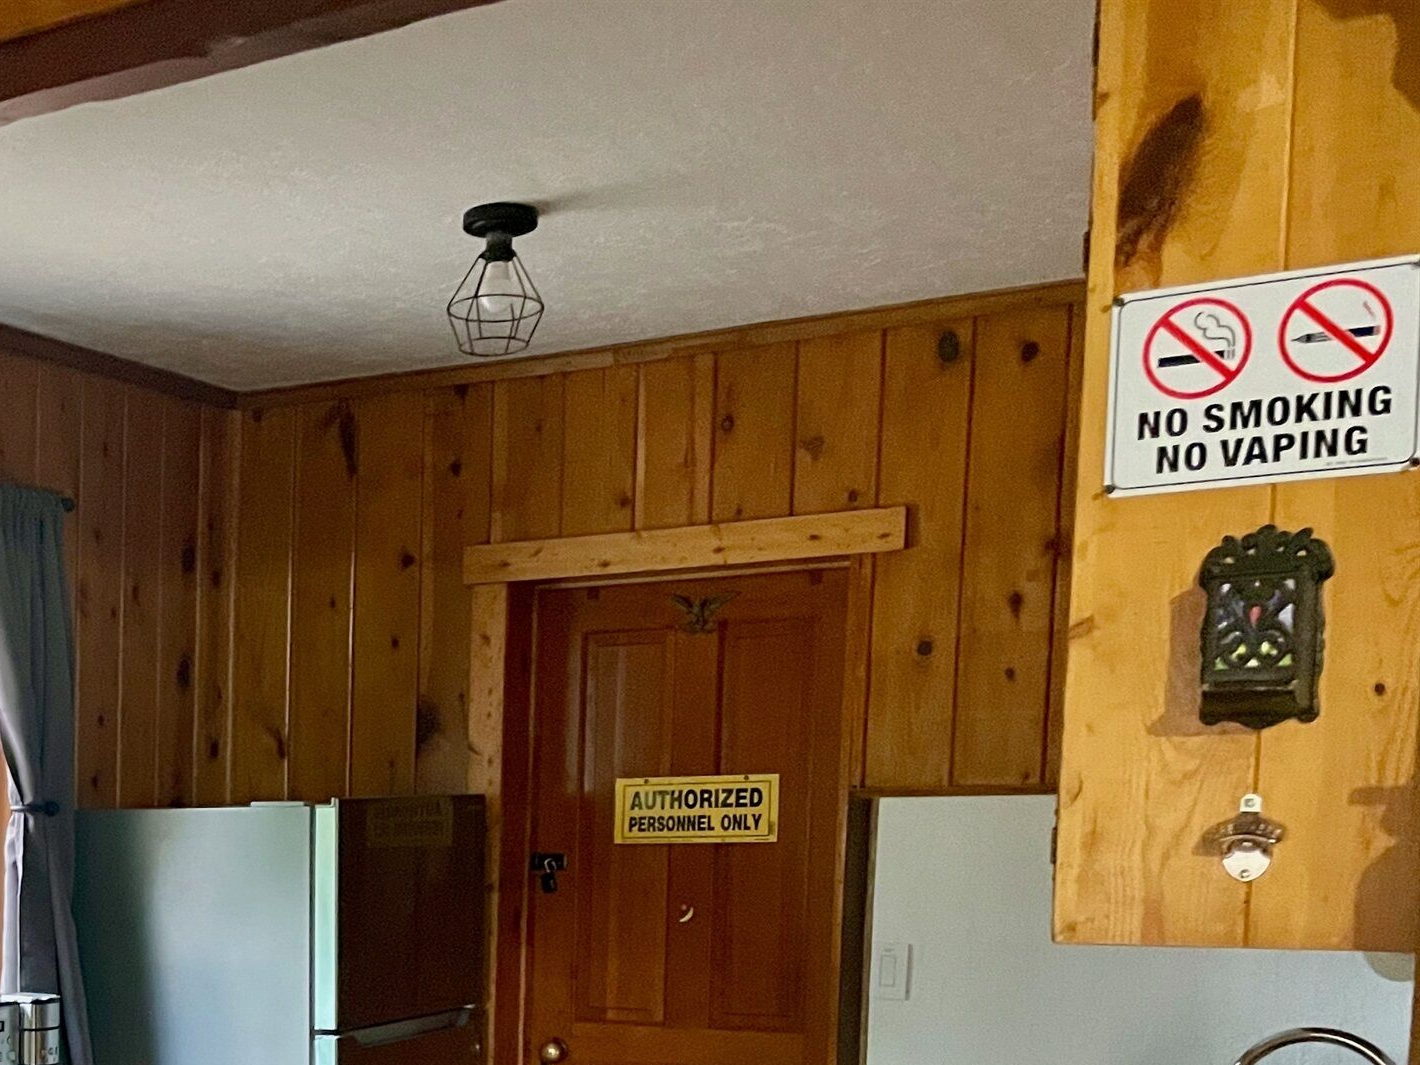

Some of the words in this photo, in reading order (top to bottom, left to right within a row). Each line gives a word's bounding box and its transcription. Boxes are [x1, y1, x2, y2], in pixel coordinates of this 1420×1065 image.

[1137, 408, 1188, 440] NO
[1202, 385, 1392, 433] SMOKING
[1155, 441, 1207, 474] NO
[1220, 425, 1369, 468] VAPING
[630, 787, 763, 811] AUTHORIZED
[628, 814, 715, 832] PERSONNEL
[720, 813, 763, 831] ONLY
